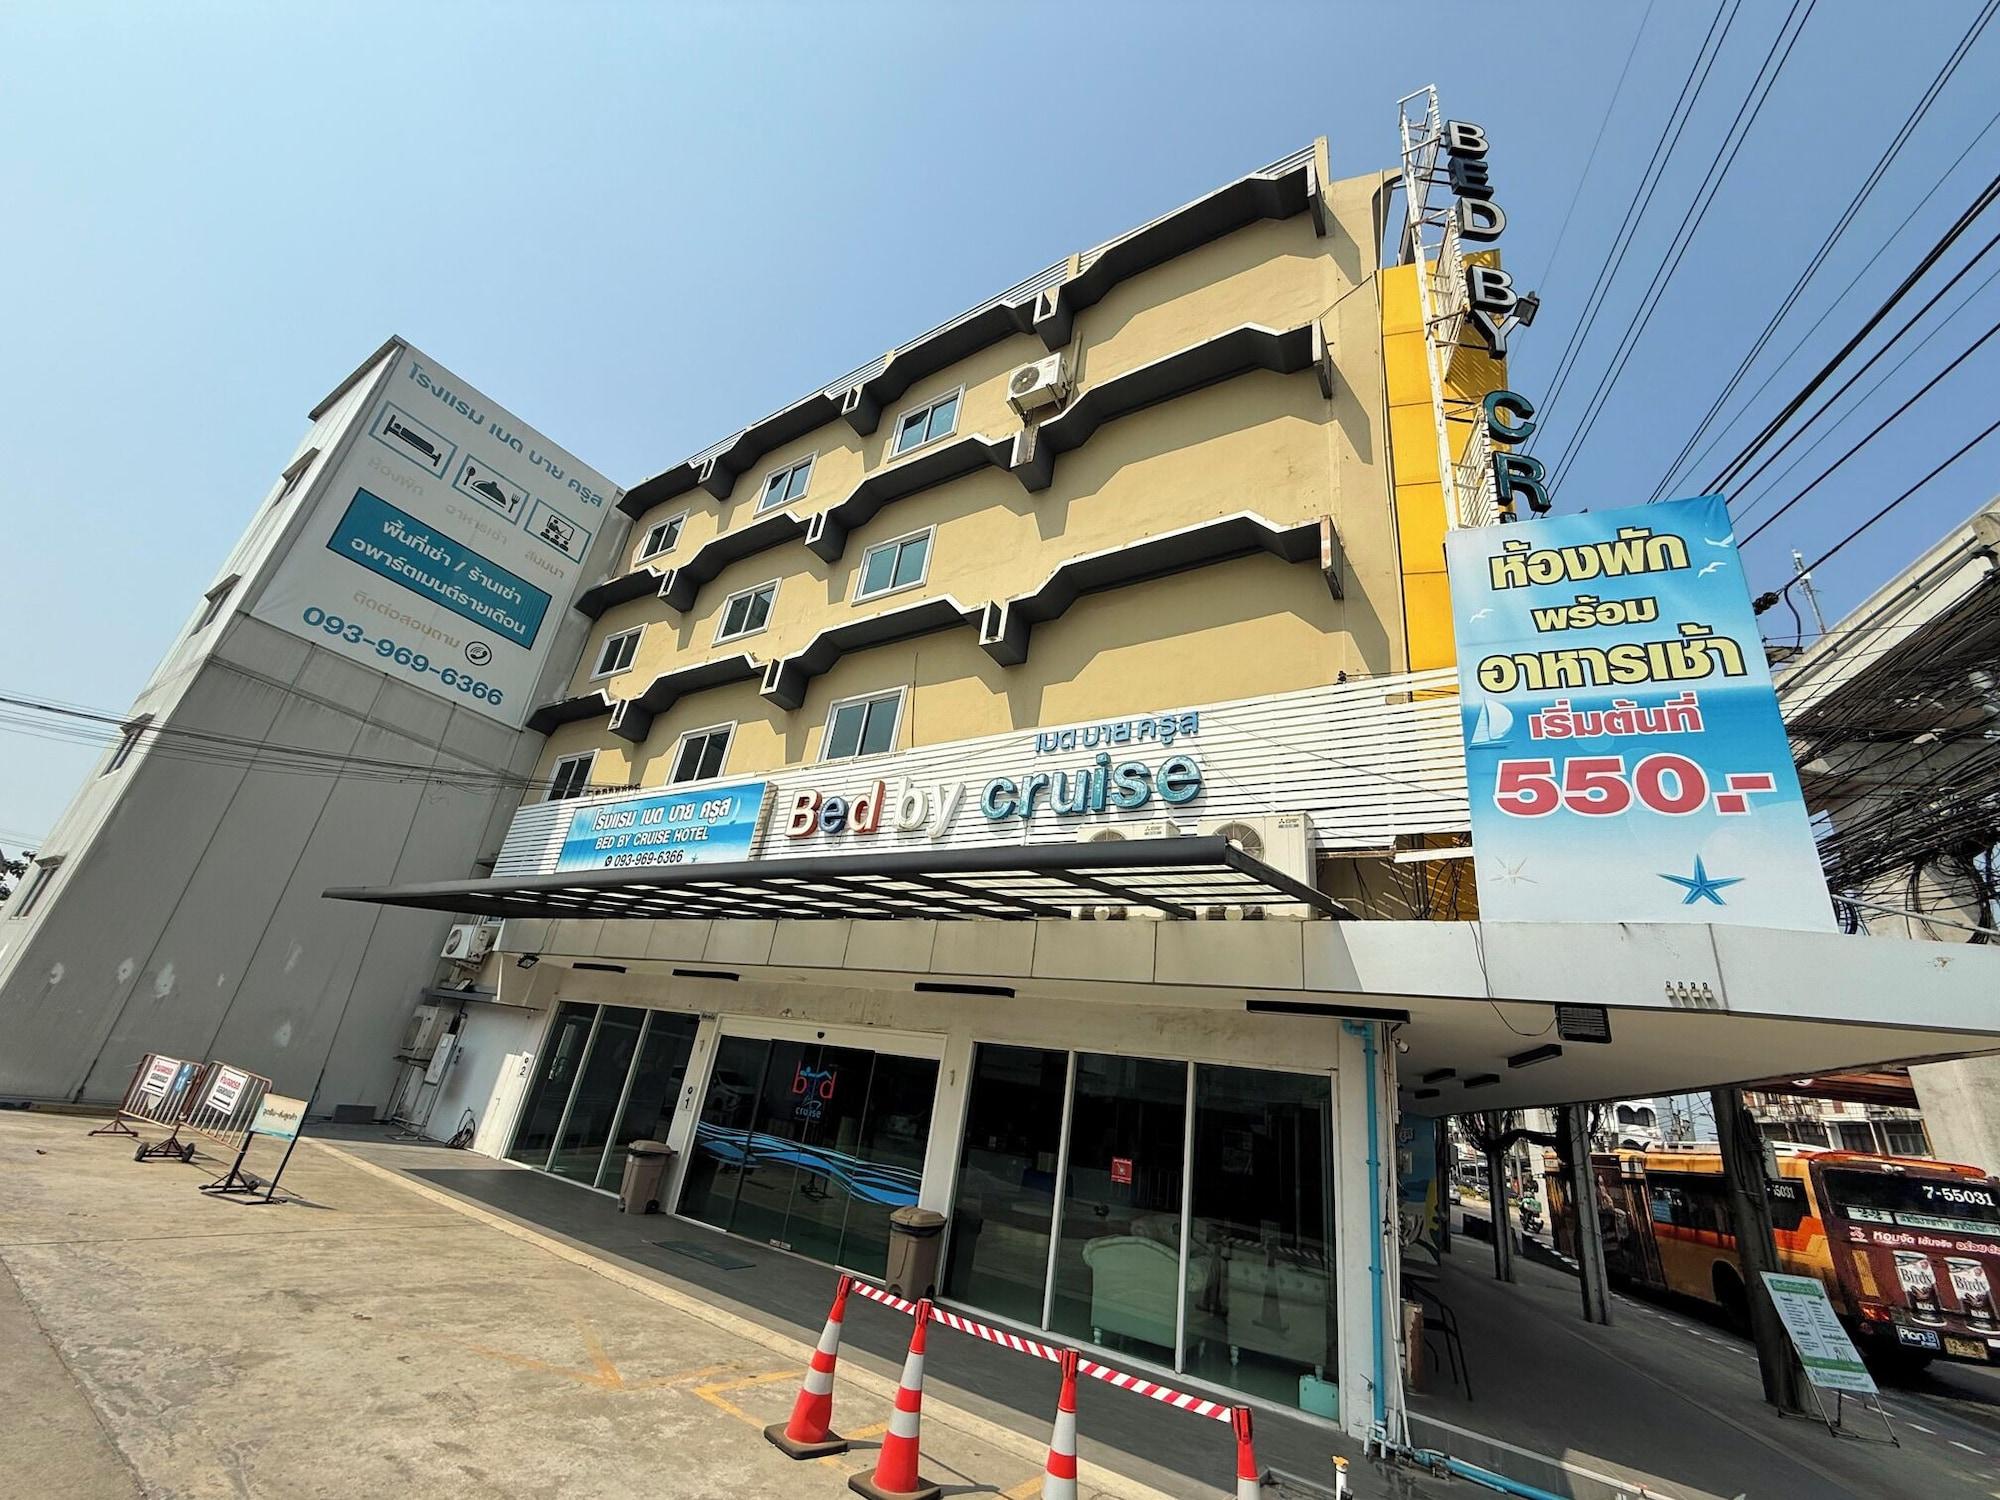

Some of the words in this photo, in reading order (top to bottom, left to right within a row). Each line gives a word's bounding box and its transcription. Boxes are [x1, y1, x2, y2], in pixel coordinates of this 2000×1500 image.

[1447, 119, 1506, 242] BED
[1466, 264, 1520, 360] BY
[408, 361, 485, 425] โรงแรม
[488, 423, 524, 454] เบด
[529, 450, 565, 480] บาย
[568, 479, 605, 508] ครูส
[1483, 391, 1551, 523] CR
[382, 519, 453, 567] พื้นที่เช่า
[467, 566, 522, 605] ร้านเช่า
[1489, 526, 1692, 590] ห้องพัก
[352, 590, 462, 650] ติดต่อสอบถาม
[1531, 595, 1659, 632] พร้อม
[302, 606, 504, 706] 093-969-6366
[1477, 622, 1748, 693] อาหารเช้า
[1035, 729, 1077, 753] เบด
[1082, 721, 1132, 748] บาย
[1138, 711, 1199, 745] ครูส
[1528, 691, 1704, 740] เริ่มต้นที่
[591, 808, 637, 831] โรงแรม
[639, 807, 666, 827] เบด
[668, 803, 695, 822] บาย
[698, 798, 732, 824] ครูส
[785, 778, 886, 839] Bed
[894, 776, 966, 839] by
[981, 752, 1202, 820] cruise
[1493, 753, 1777, 818] 550.-
[595, 836, 614, 850] BED
[617, 834, 632, 849] BY
[633, 830, 670, 846] CRUISE
[673, 826, 709, 843] HOTEL
[613, 849, 684, 867] 093-969-6366
[1922, 1185, 1996, 1206] 7-55031
[1900, 1268, 1932, 1285] Birdy
[1954, 1275, 1987, 1291] Birdy
